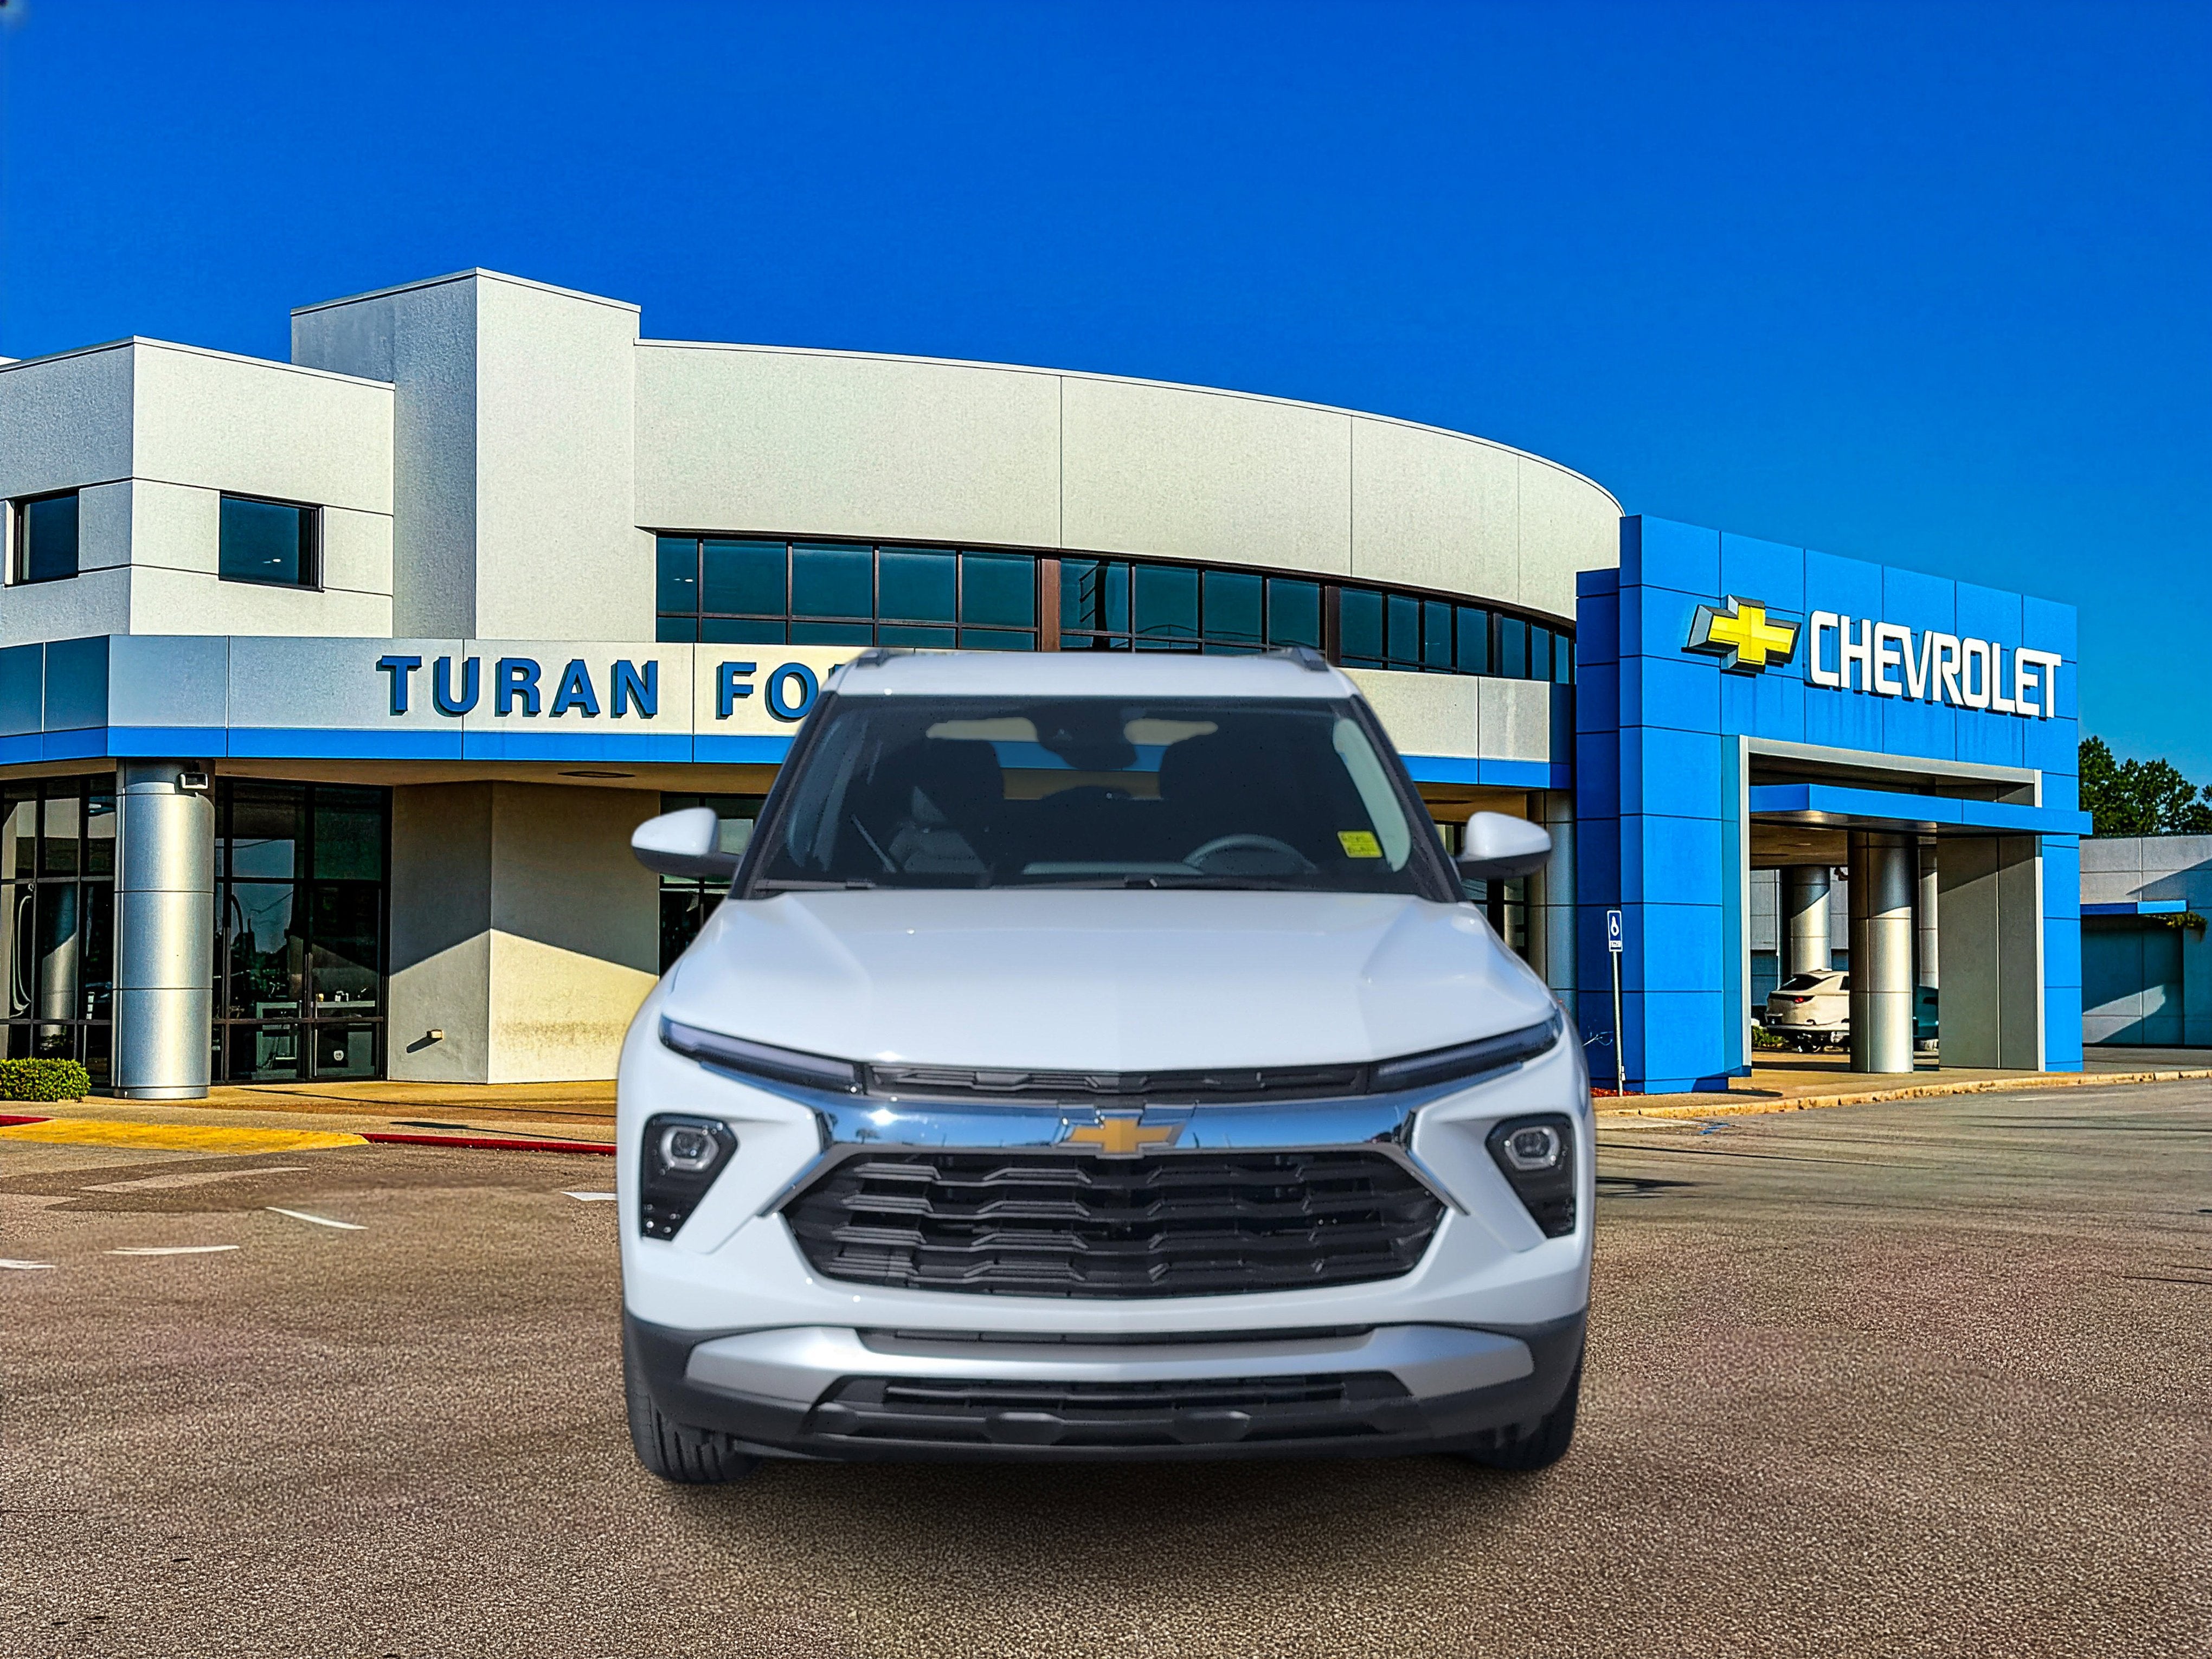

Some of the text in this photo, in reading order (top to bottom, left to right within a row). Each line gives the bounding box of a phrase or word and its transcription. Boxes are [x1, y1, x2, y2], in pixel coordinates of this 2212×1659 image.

[376, 655, 845, 723] TURAN FO
[1809, 610, 2062, 719] CHEVROLET
